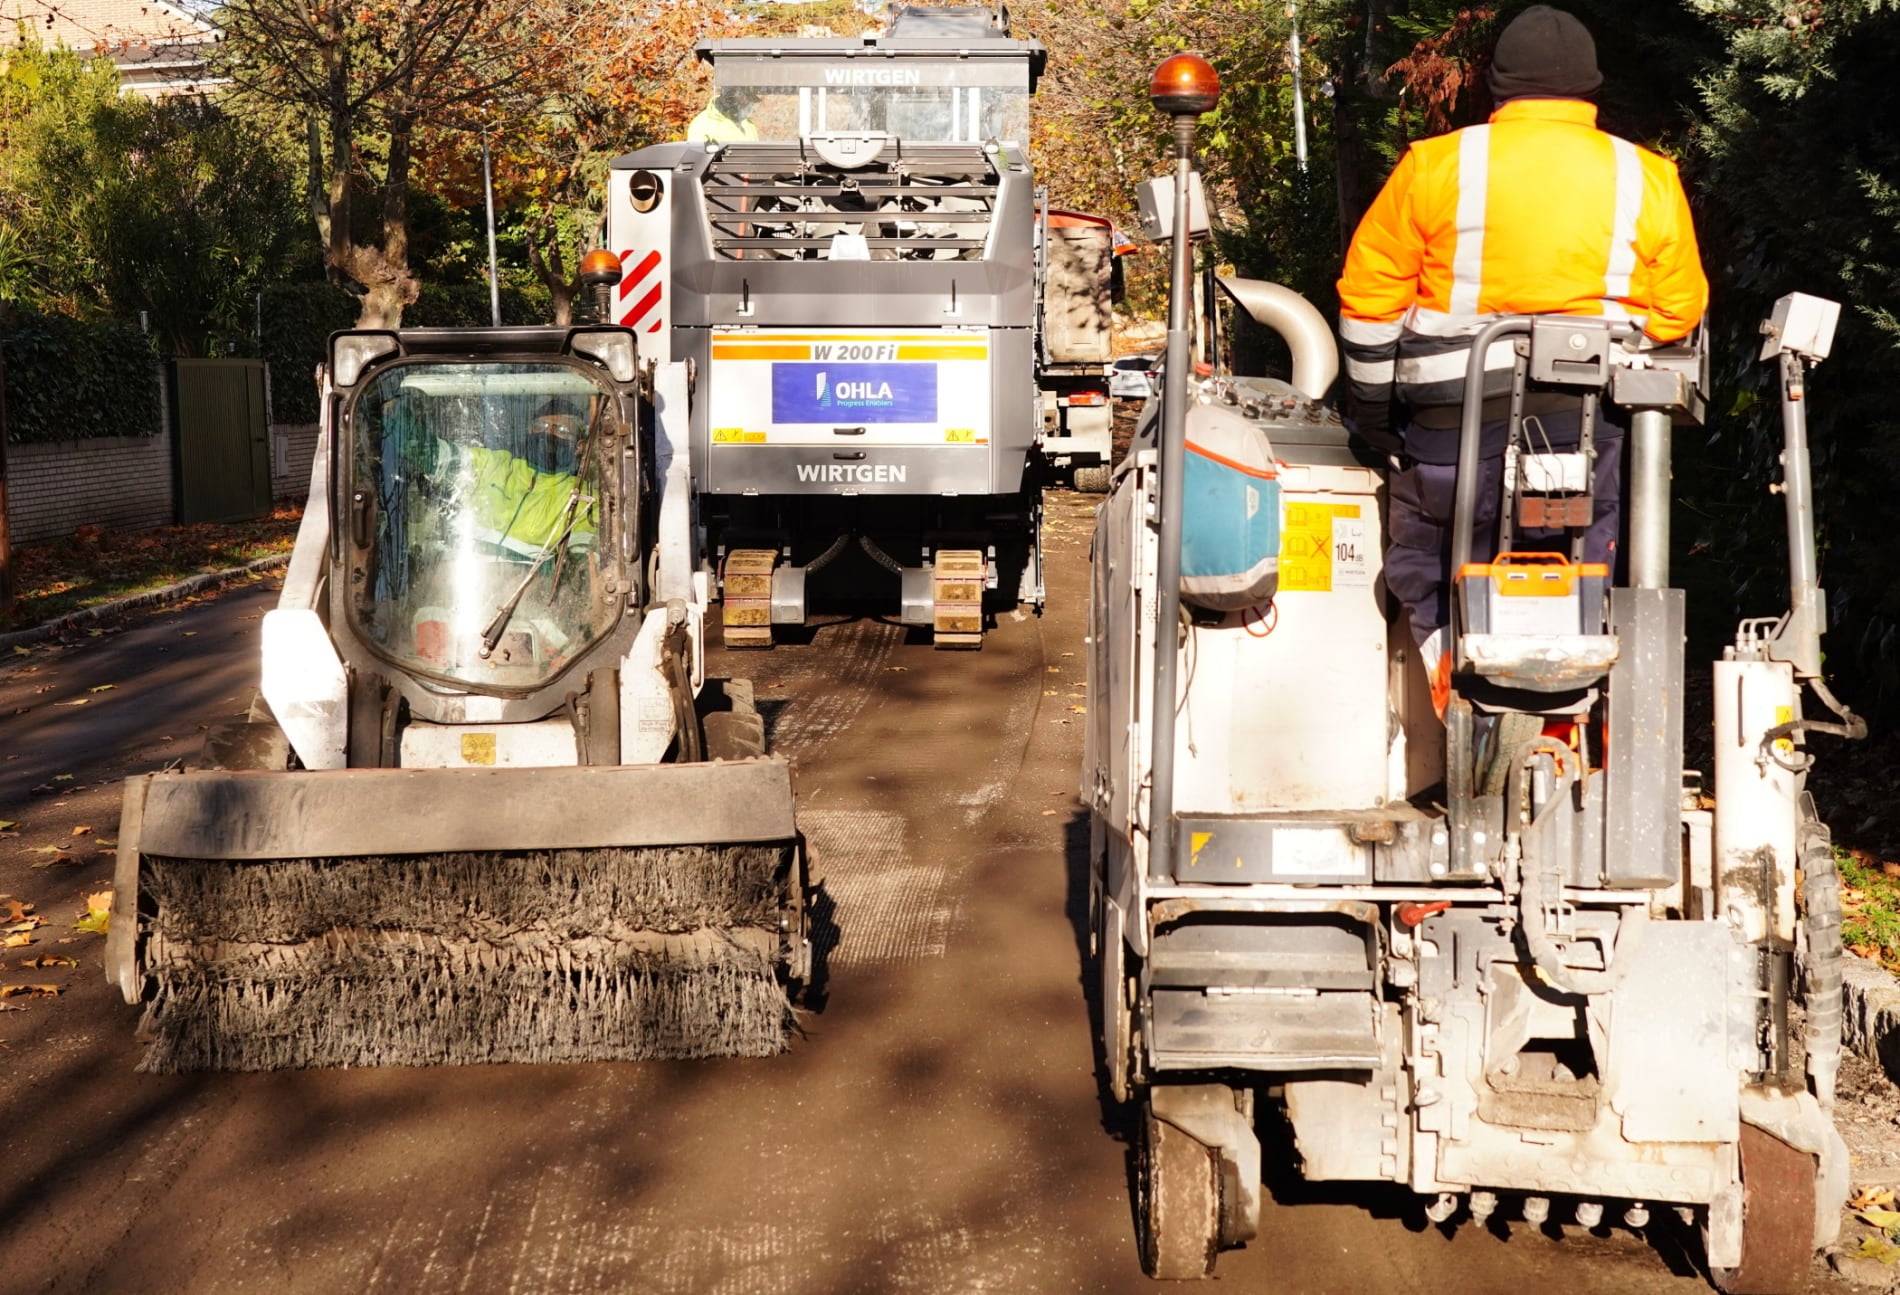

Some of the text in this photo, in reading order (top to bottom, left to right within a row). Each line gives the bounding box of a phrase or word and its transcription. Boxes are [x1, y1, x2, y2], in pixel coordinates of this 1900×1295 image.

[825, 69, 920, 84] WIRTGEN
[814, 345, 833, 361] W
[836, 382, 893, 399] OHLA
[837, 400, 865, 408] Progress
[796, 464, 907, 483] WIRTGEN
[1335, 543, 1355, 562] 104
